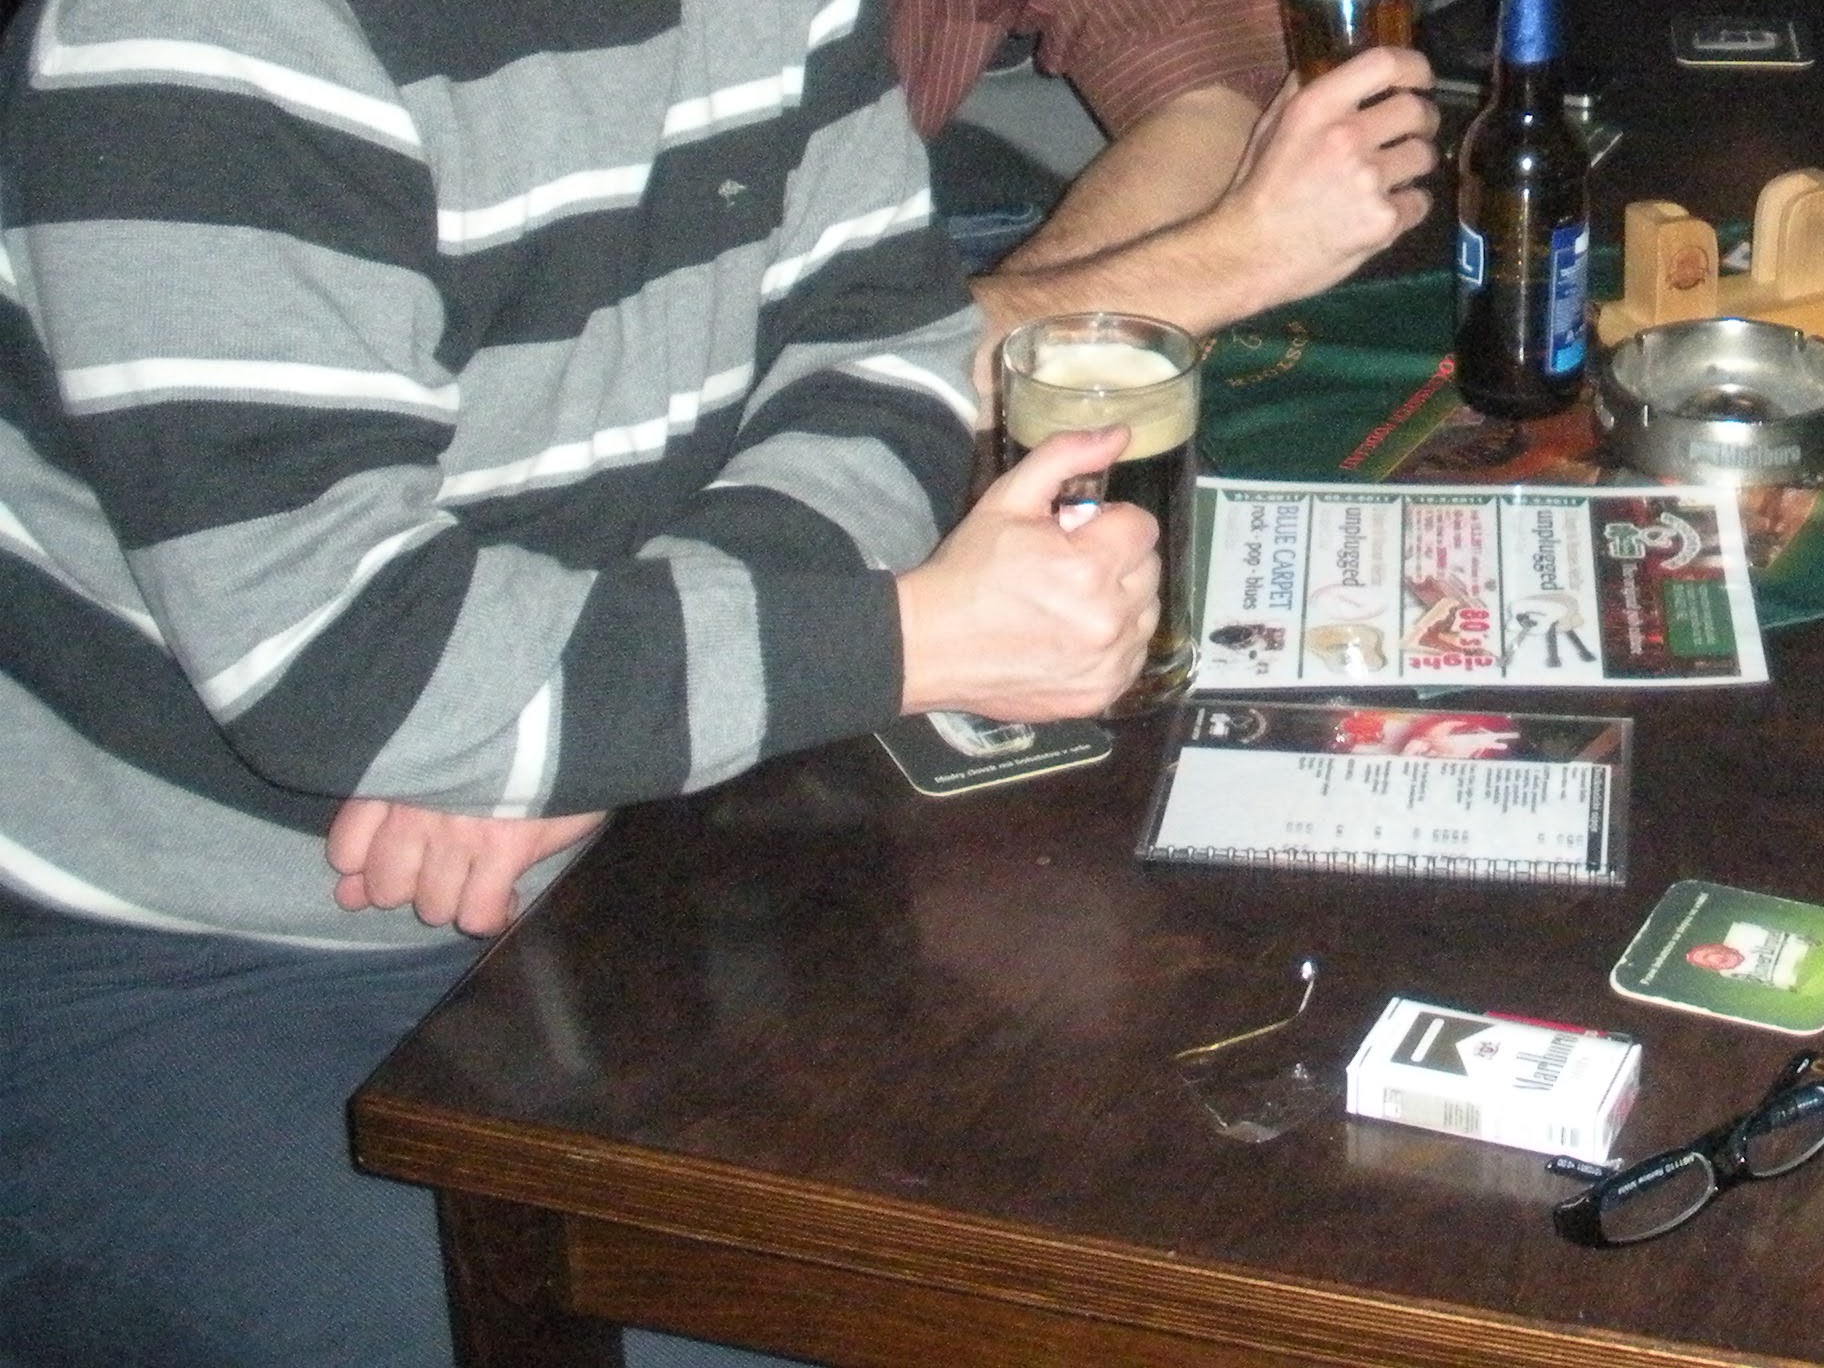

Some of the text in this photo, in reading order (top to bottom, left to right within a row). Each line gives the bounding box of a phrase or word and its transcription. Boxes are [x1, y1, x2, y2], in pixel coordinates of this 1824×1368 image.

[1242, 505, 1268, 610] rock pop blues
[1269, 505, 1299, 611] BLUE CARPET
[1336, 507, 1367, 588] unplugged
[1531, 510, 1565, 590] unplugged
